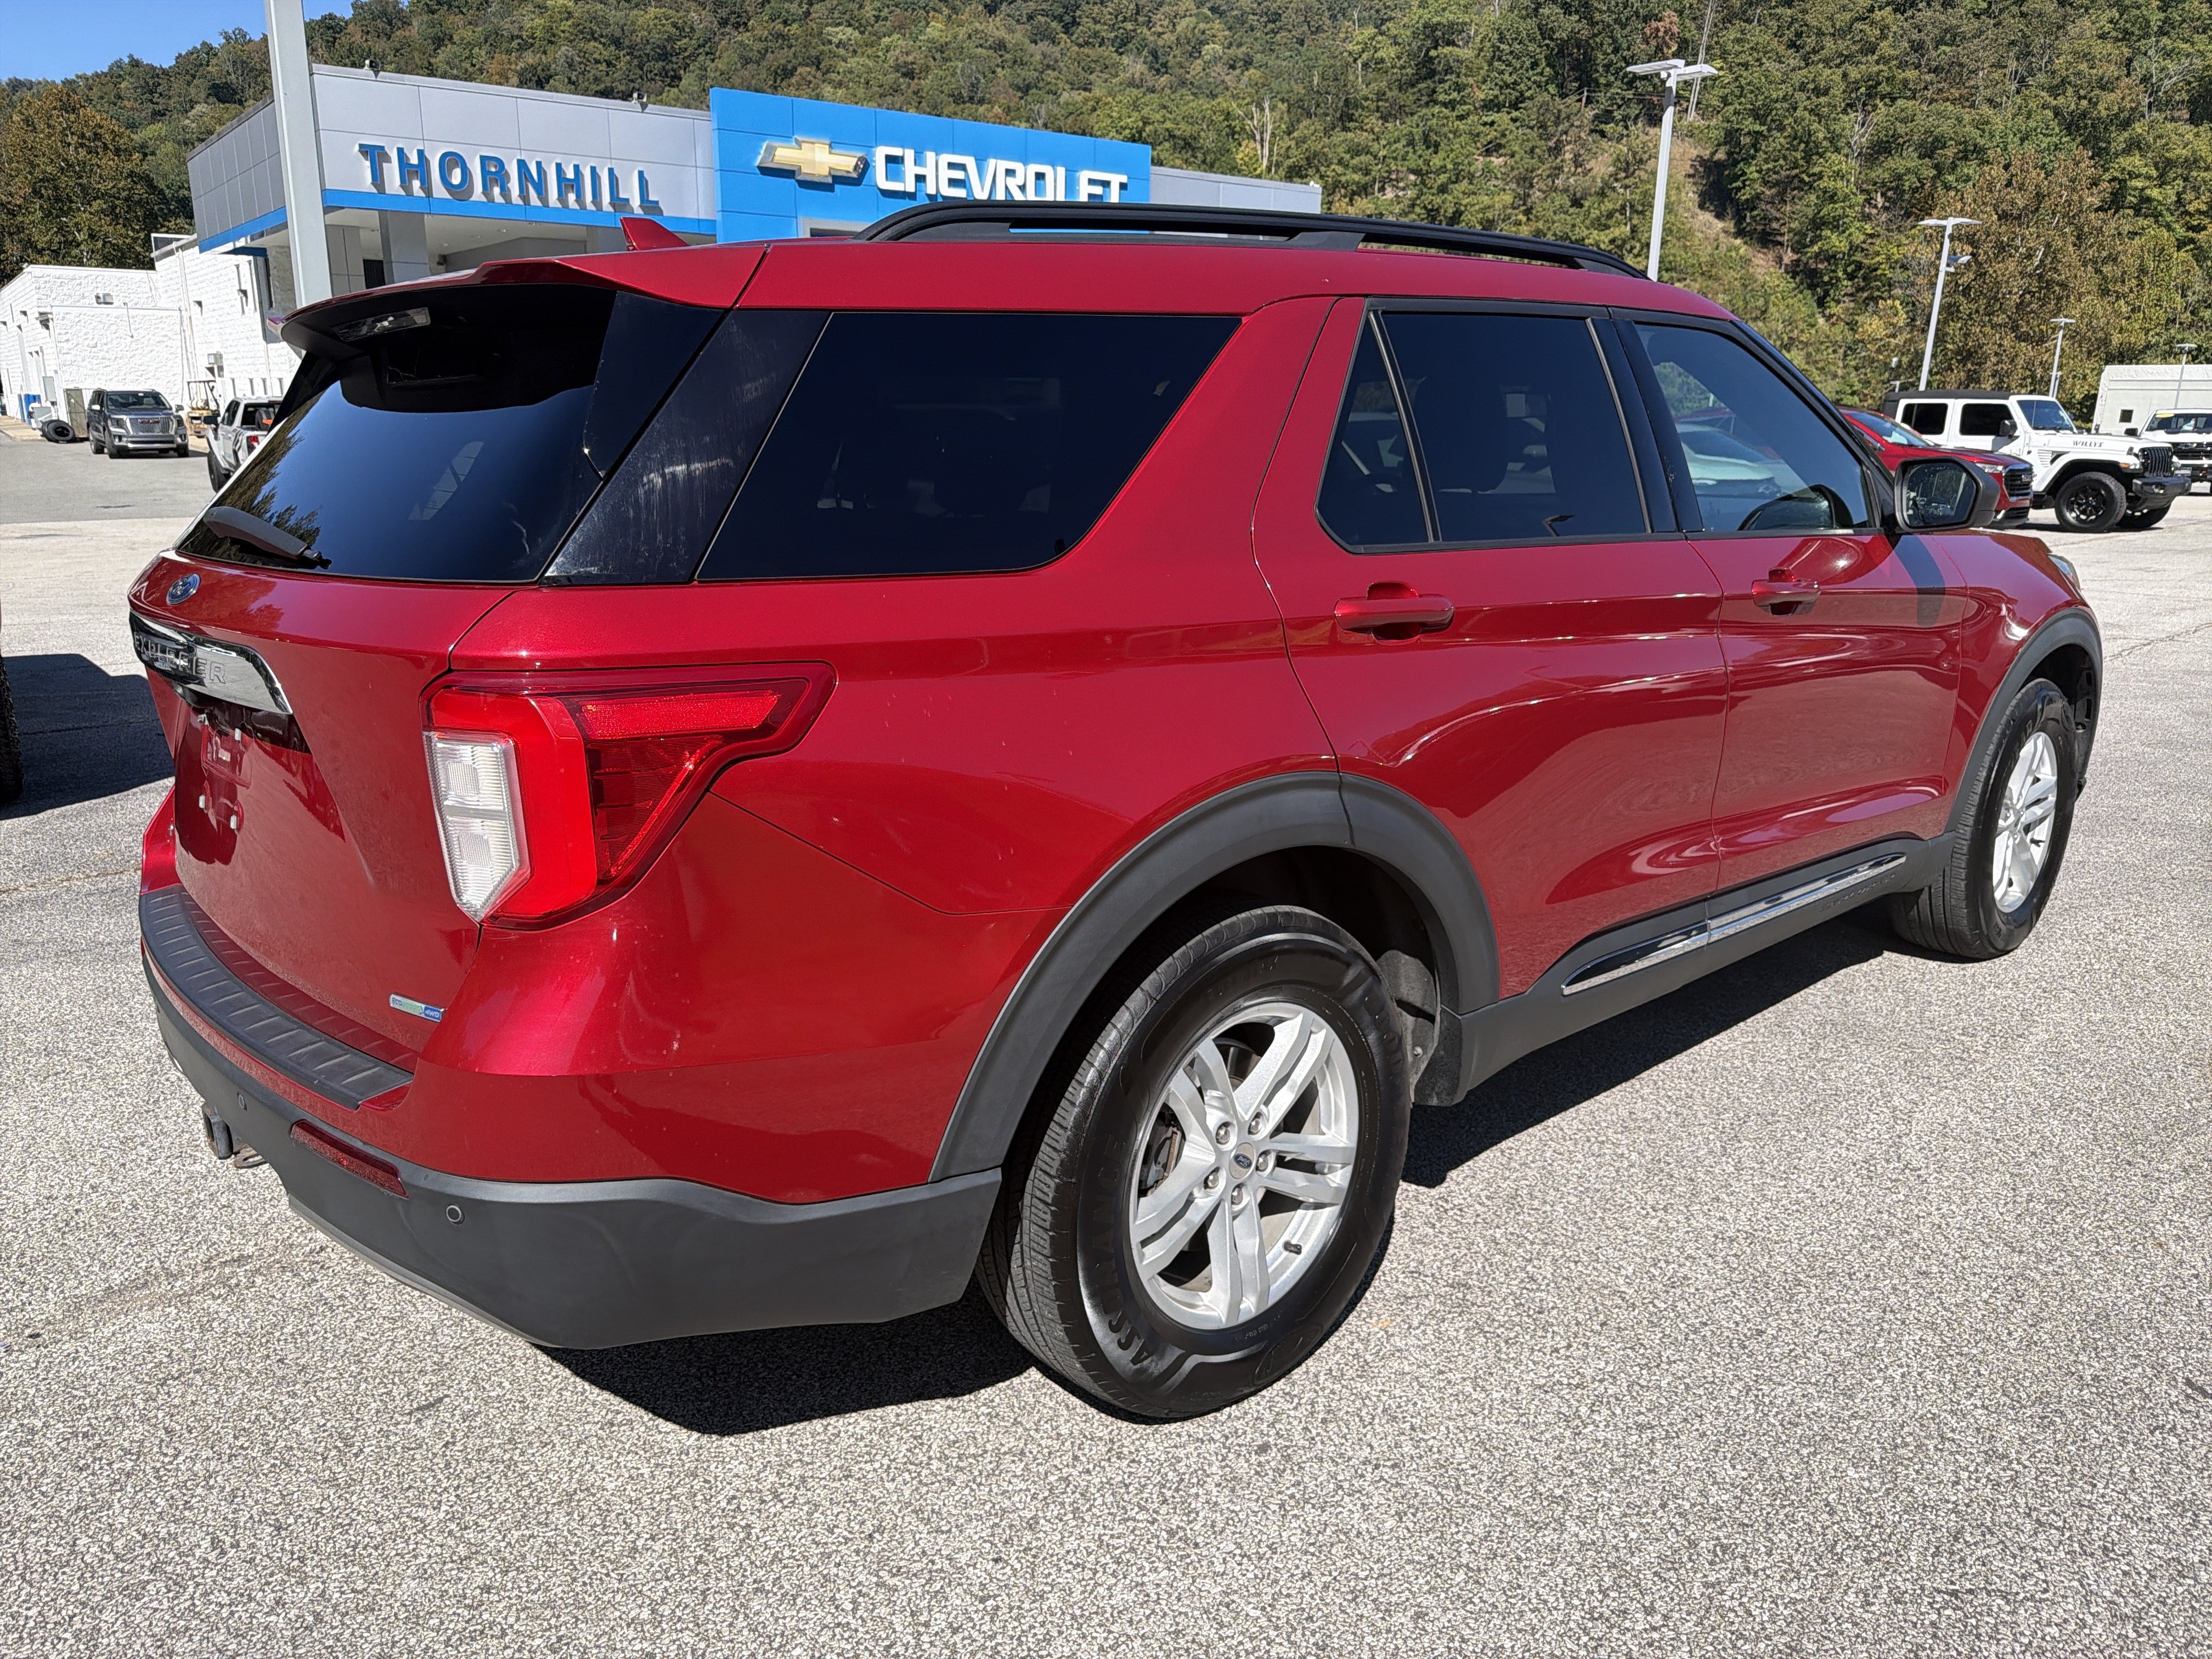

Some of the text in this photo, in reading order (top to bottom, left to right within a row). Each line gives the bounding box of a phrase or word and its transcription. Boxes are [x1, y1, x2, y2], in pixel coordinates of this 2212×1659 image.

[358, 143, 659, 206] THORNHILL
[876, 145, 1128, 203] CHEVROLET
[425, 1009, 440, 1019] 4WD
